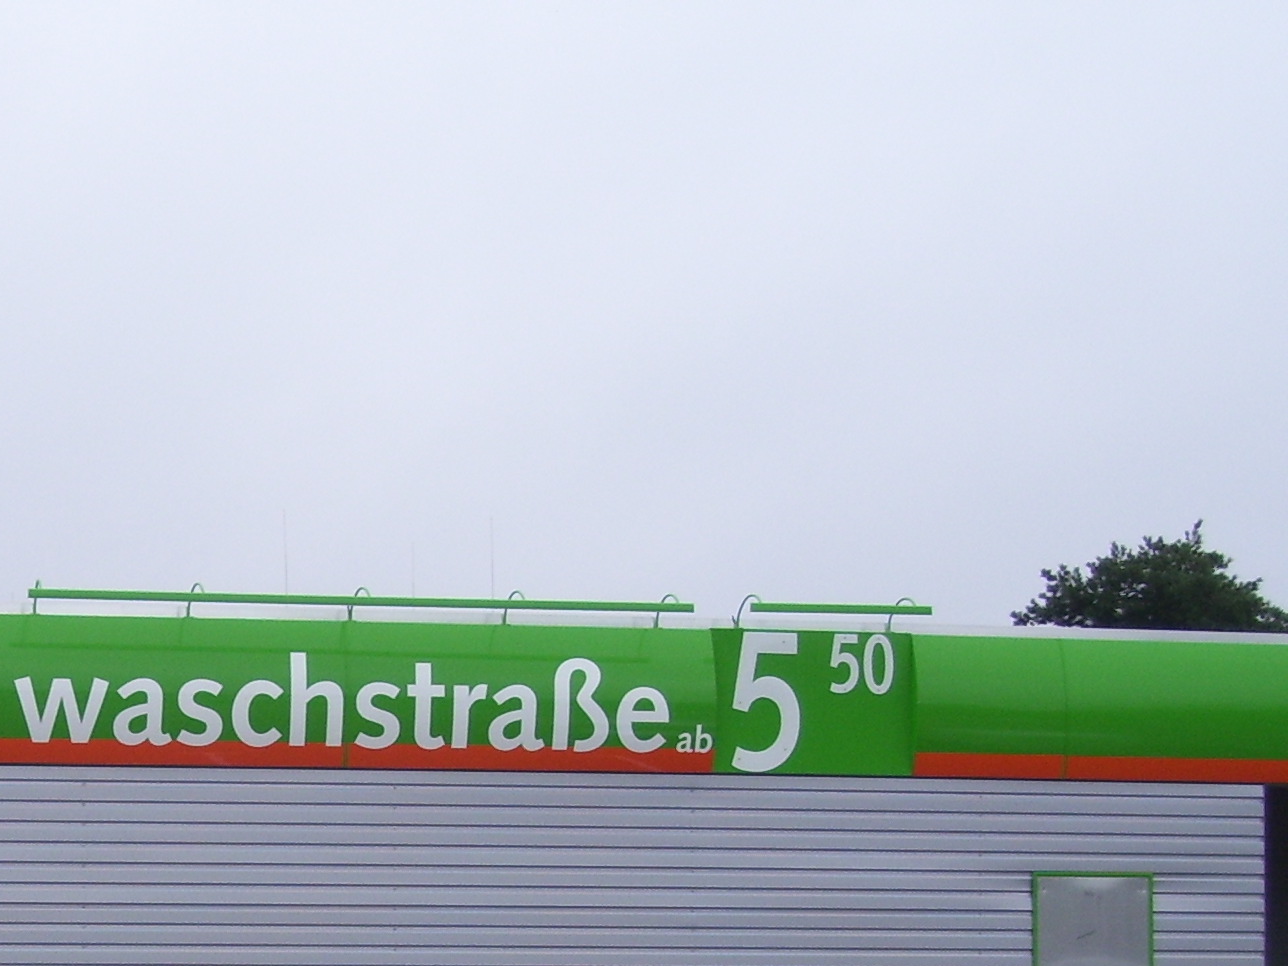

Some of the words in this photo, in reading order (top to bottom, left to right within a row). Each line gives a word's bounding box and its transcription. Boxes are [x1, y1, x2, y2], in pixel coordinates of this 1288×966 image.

[14, 651, 670, 753] waschstraße
[676, 724, 713, 754] ab
[731, 632, 801, 772] 5
[829, 633, 896, 695] 50
